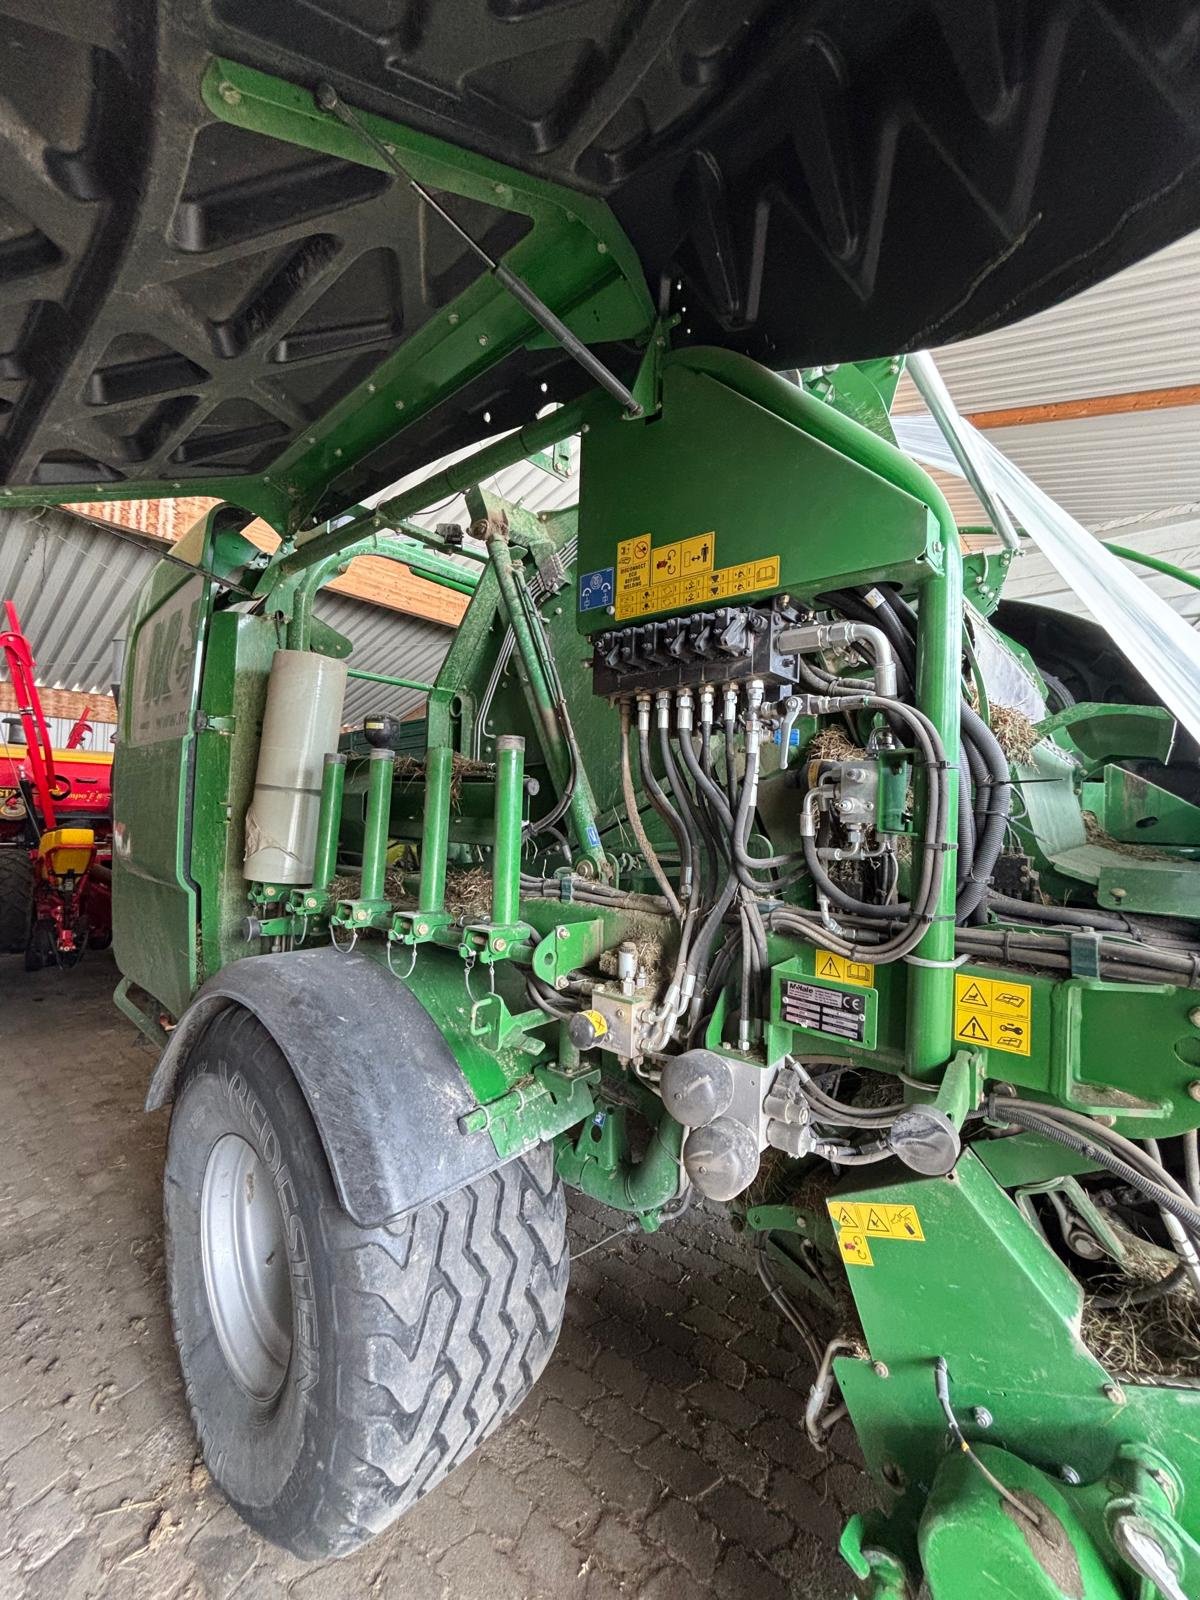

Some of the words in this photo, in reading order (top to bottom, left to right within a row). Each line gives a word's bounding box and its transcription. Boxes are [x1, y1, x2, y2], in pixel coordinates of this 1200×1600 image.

[621, 562, 647, 574] DISCONNECT
[624, 581, 642, 590] WELDING
[0, 789, 17, 798] STA
[217, 1058, 321, 1392] VREDESTEIN
